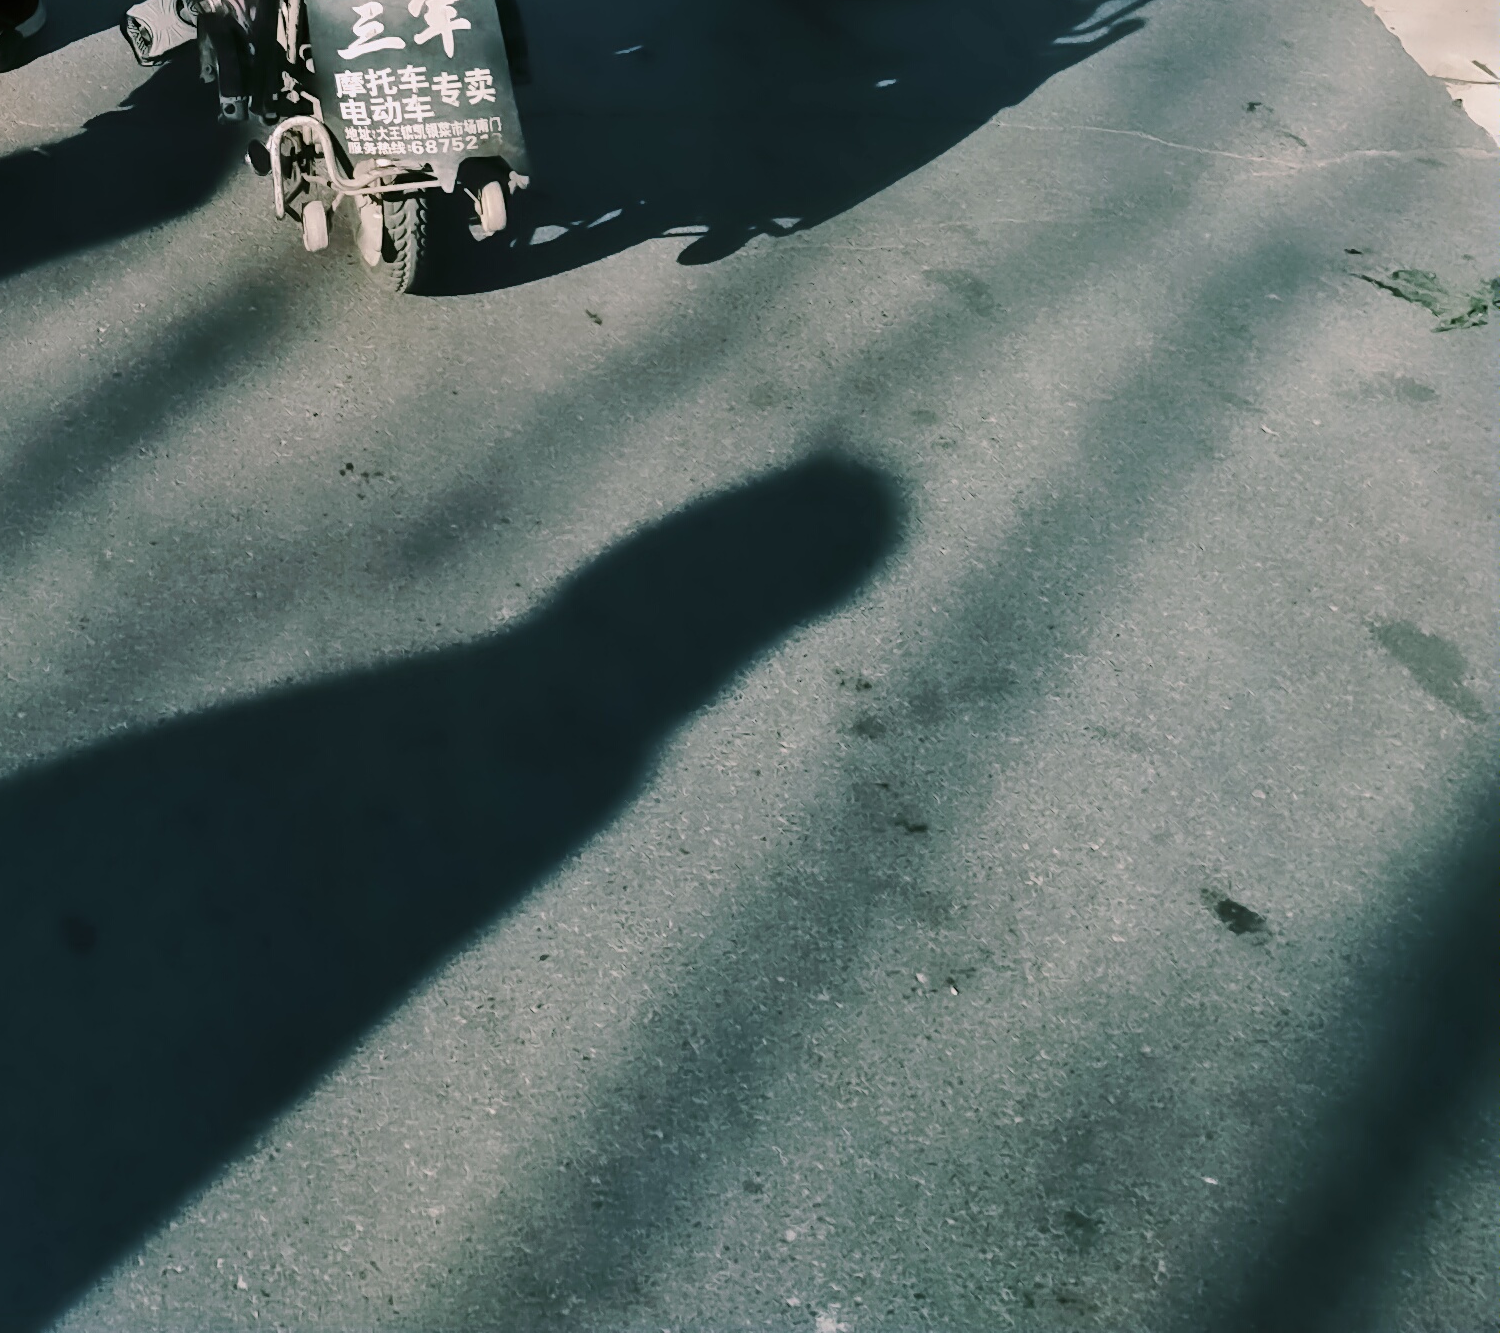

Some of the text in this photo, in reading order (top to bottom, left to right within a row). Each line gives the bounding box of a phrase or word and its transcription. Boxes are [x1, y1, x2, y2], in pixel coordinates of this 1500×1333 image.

[334, 64, 430, 99] 摩托车
[431, 67, 497, 108] 专卖
[339, 93, 436, 126] 电动车
